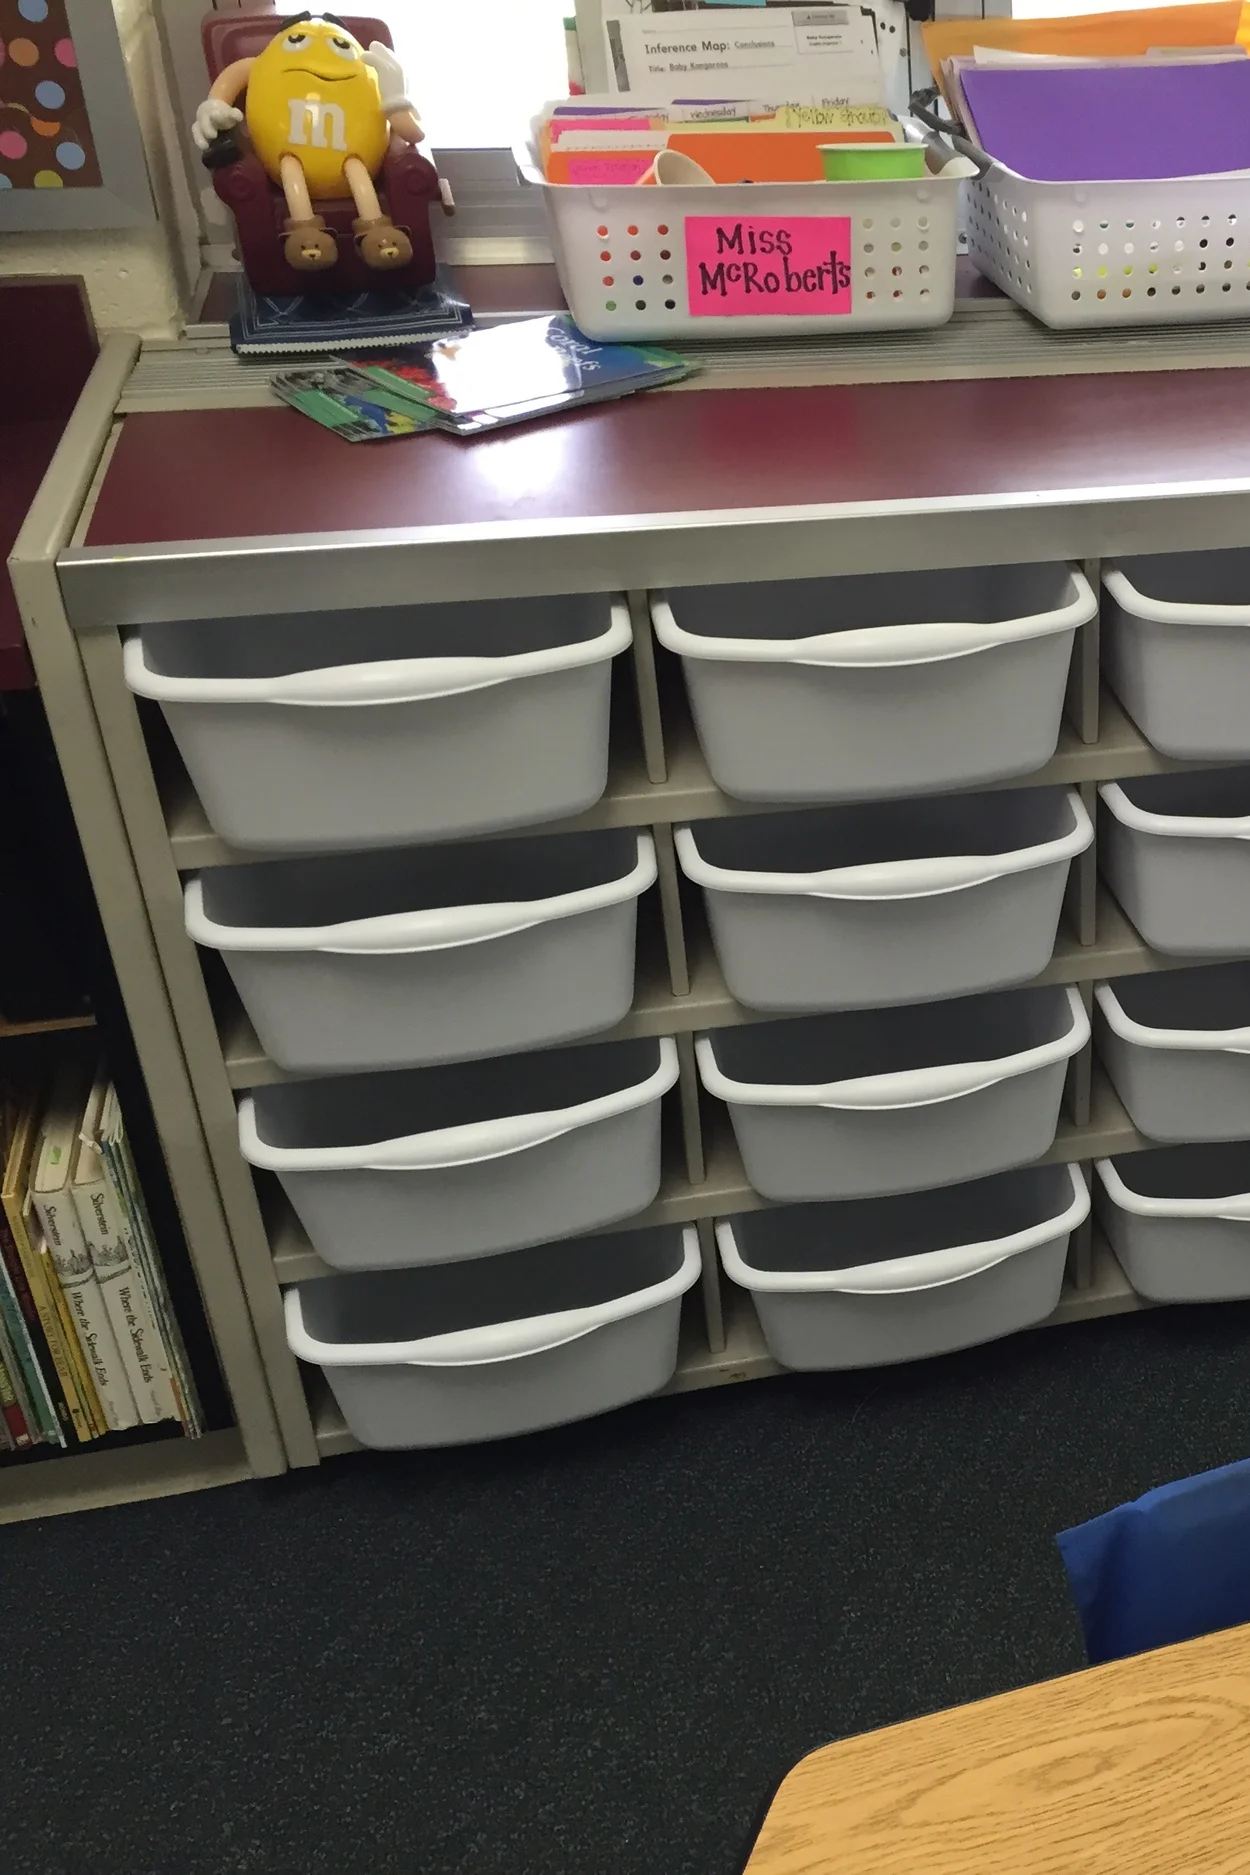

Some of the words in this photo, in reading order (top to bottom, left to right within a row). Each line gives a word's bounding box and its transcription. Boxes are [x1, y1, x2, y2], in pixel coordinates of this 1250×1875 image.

[644, 43, 697, 55] Inference
[701, 40, 731, 53] Map:
[734, 40, 775, 49] Conclusions
[648, 65, 666, 73] Title:
[669, 63, 687, 72] Baby
[690, 61, 729, 71] Kangaroos
[287, 98, 347, 151] m
[716, 223, 793, 255] Miss
[698, 250, 852, 297] McRoberts
[44, 1204, 62, 1246] Silverstein
[90, 1192, 109, 1236] Silverstein
[119, 1286, 133, 1317] Where
[126, 1314, 138, 1327] the
[71, 1291, 85, 1319] Where
[79, 1314, 91, 1330] the
[85, 1332, 104, 1366] Sidewalk
[95, 1365, 109, 1387] Ends
[130, 1327, 149, 1363] Sidewalk
[140, 1363, 153, 1384] Ends
